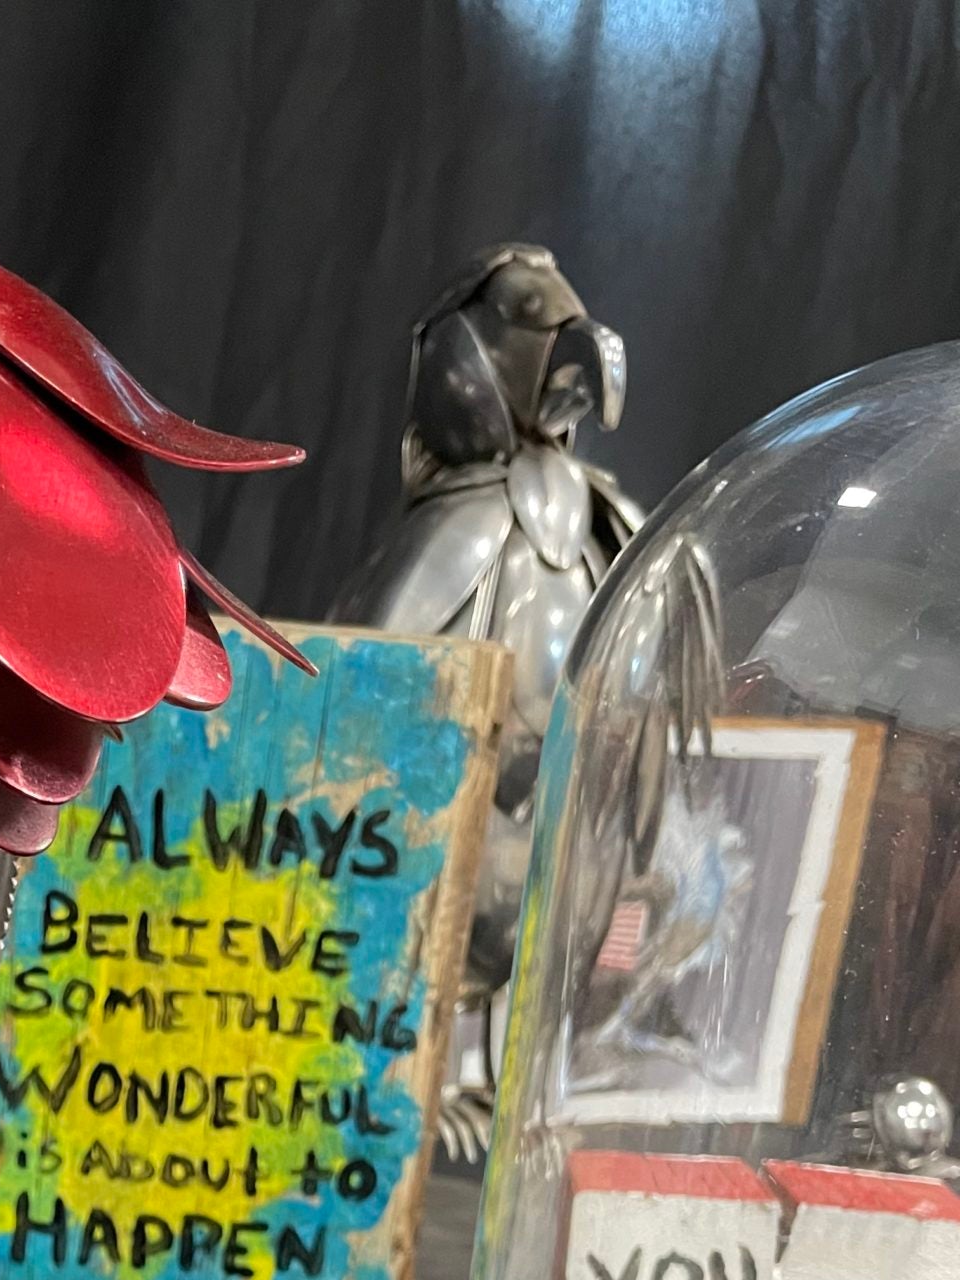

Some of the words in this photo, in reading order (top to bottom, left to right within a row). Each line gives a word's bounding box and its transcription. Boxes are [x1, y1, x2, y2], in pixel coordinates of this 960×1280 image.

[86, 784, 399, 879] ALWAYS
[41, 889, 361, 977] BELIEVE
[10, 966, 418, 1053] SOMETHING
[290, 1148, 378, 1200] to
[10, 1192, 326, 1279] HAPPEN
